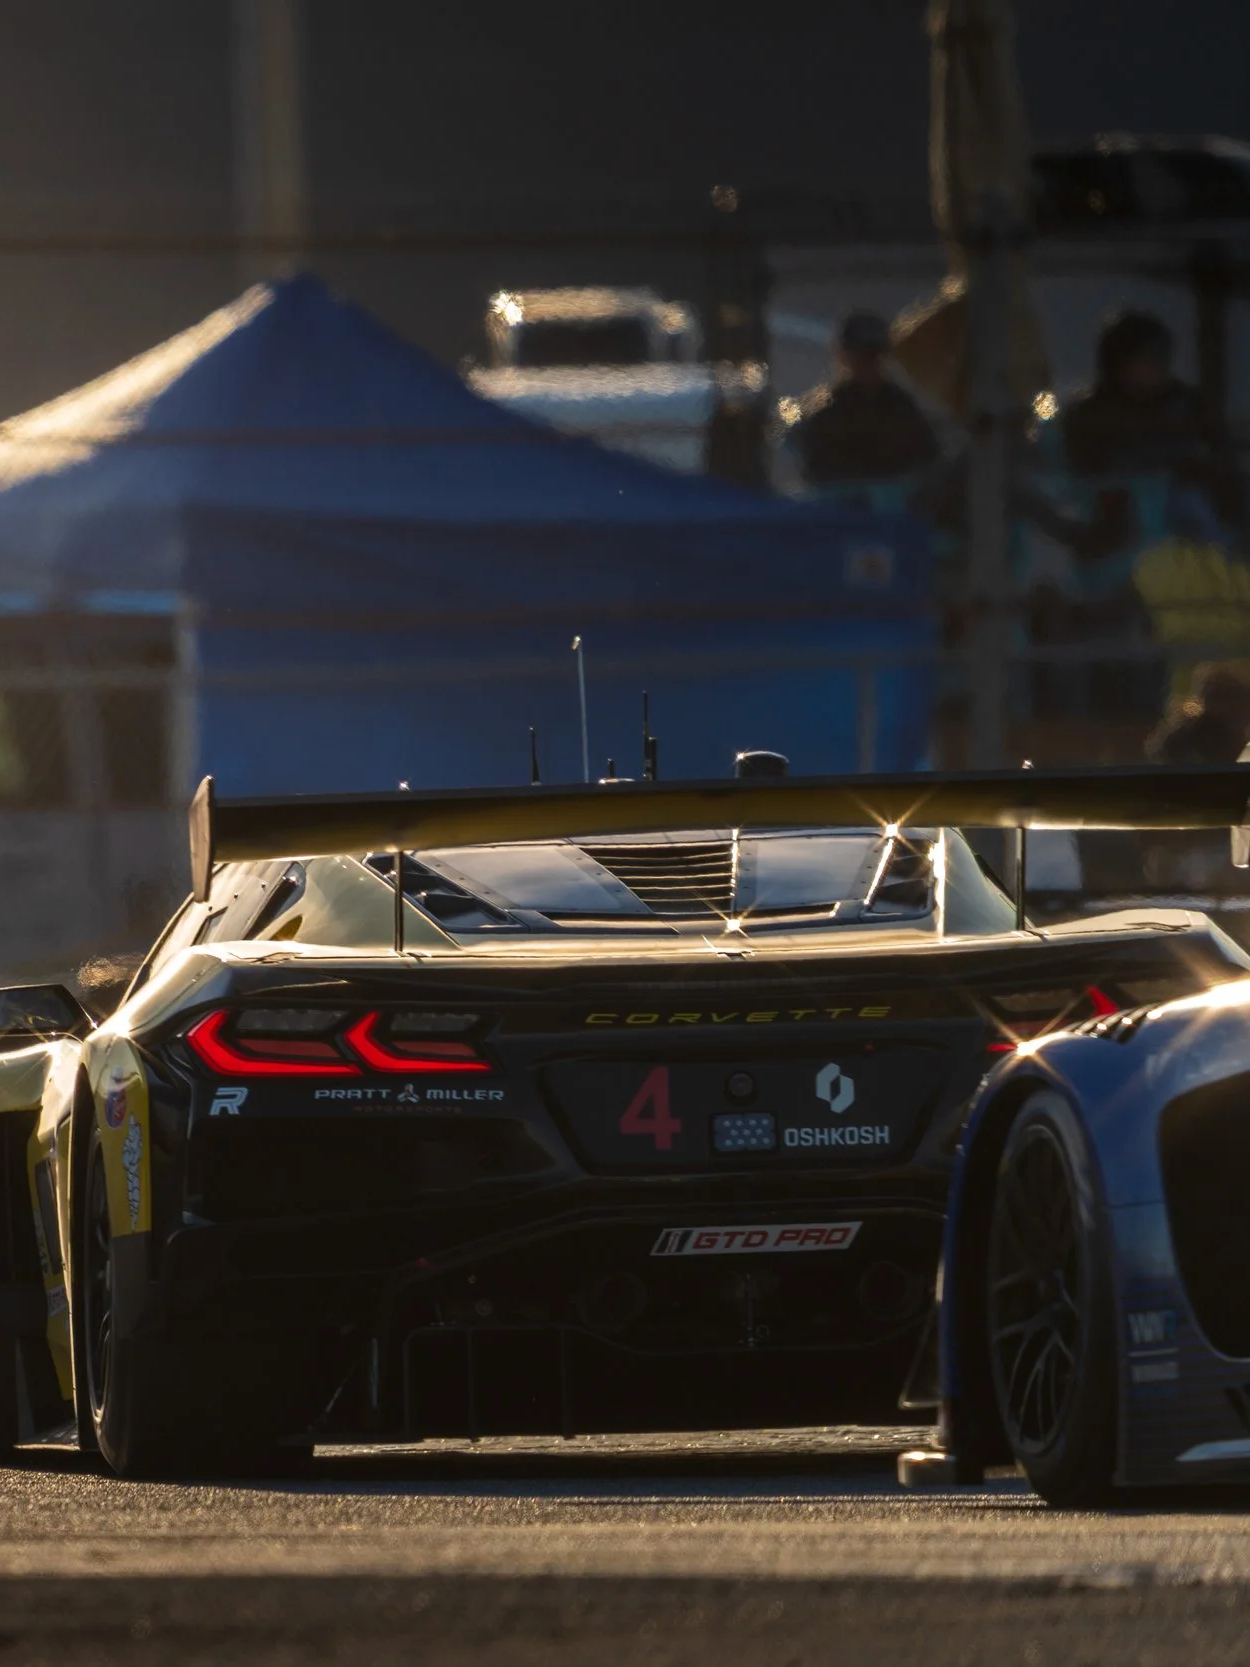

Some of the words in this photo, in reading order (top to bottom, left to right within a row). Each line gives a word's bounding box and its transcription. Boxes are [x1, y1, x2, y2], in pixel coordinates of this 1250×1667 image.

[585, 1005, 892, 1025] CORVETTE
[314, 1088, 391, 1100] PRATT
[426, 1088, 505, 1101] MILLER
[618, 1065, 682, 1151] 4
[783, 1125, 891, 1148] OSHKOSH
[692, 1230, 768, 1249] GTD
[774, 1227, 851, 1246] PRO
